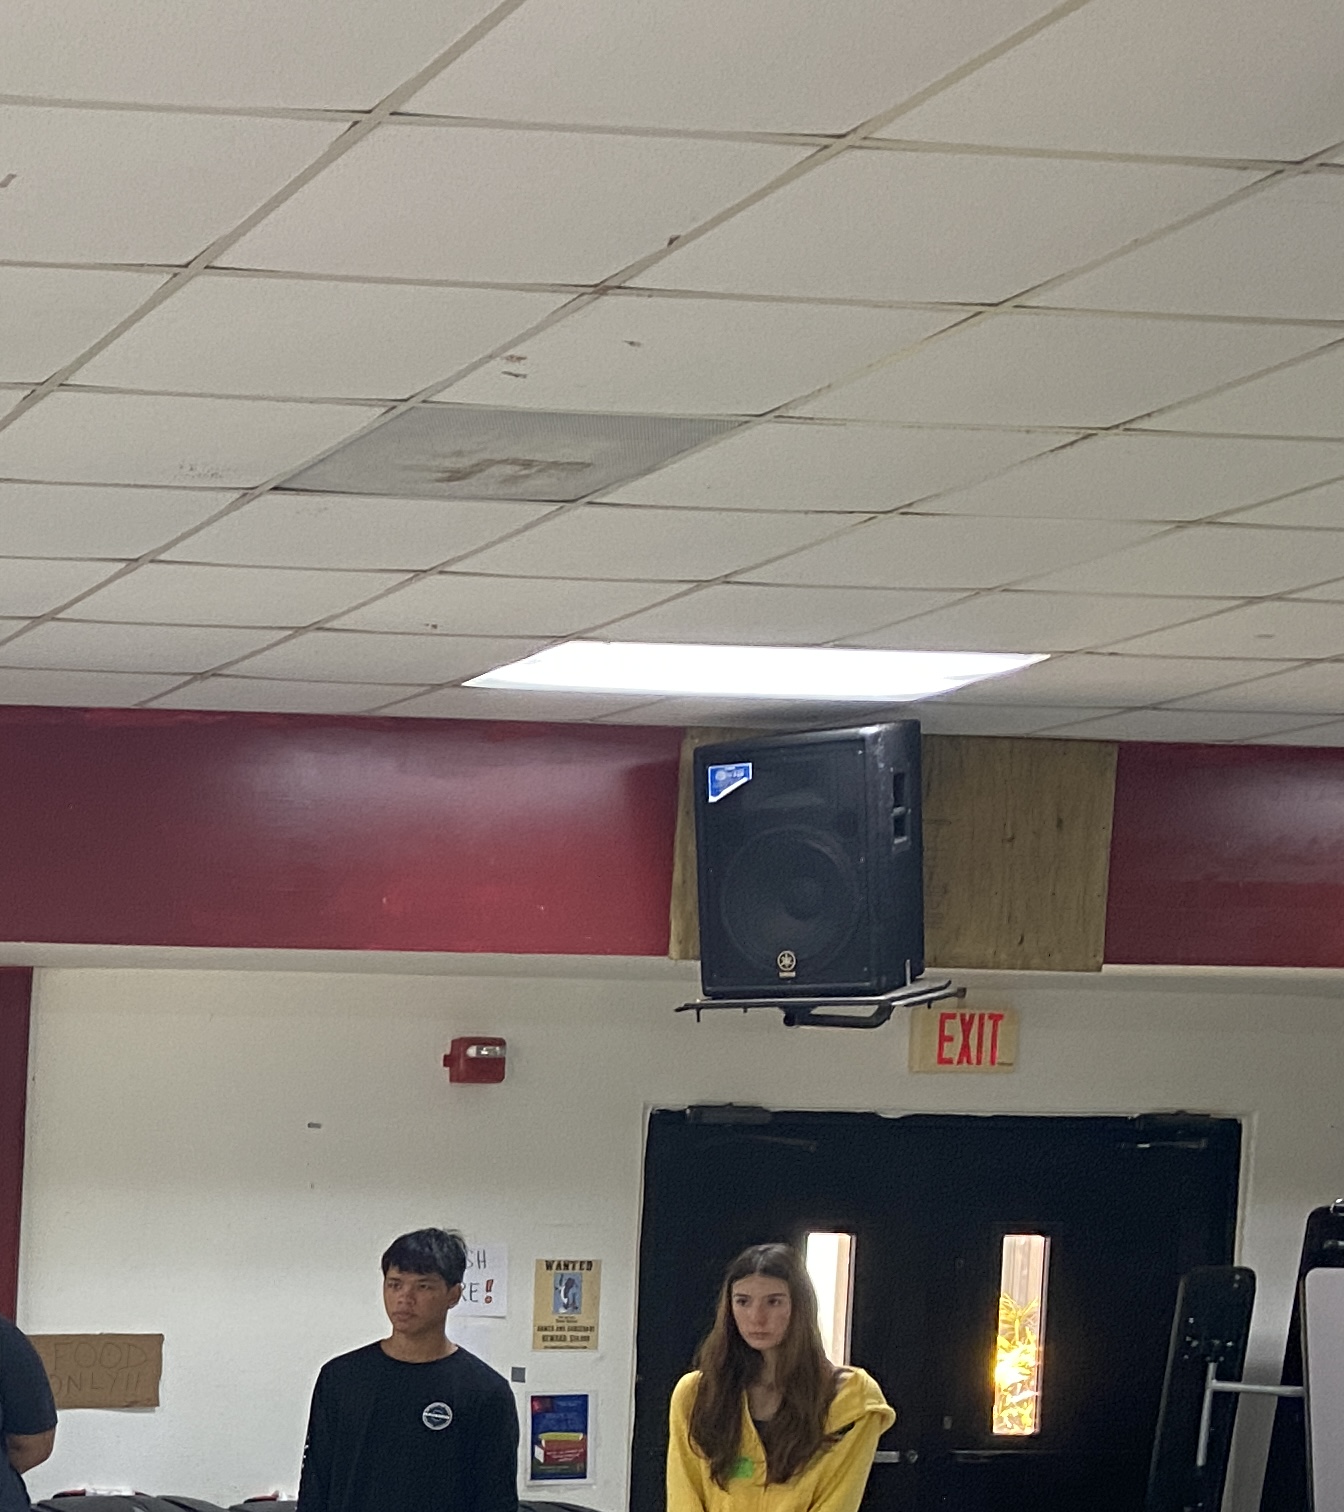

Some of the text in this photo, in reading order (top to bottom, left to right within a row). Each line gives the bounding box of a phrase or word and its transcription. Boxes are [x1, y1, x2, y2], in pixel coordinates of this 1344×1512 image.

[937, 1012, 1004, 1066] EXIT
[465, 1249, 487, 1270] SH
[544, 1259, 594, 1272] WANTED
[461, 1278, 494, 1304] RE!
[53, 1341, 148, 1371] FOOD
